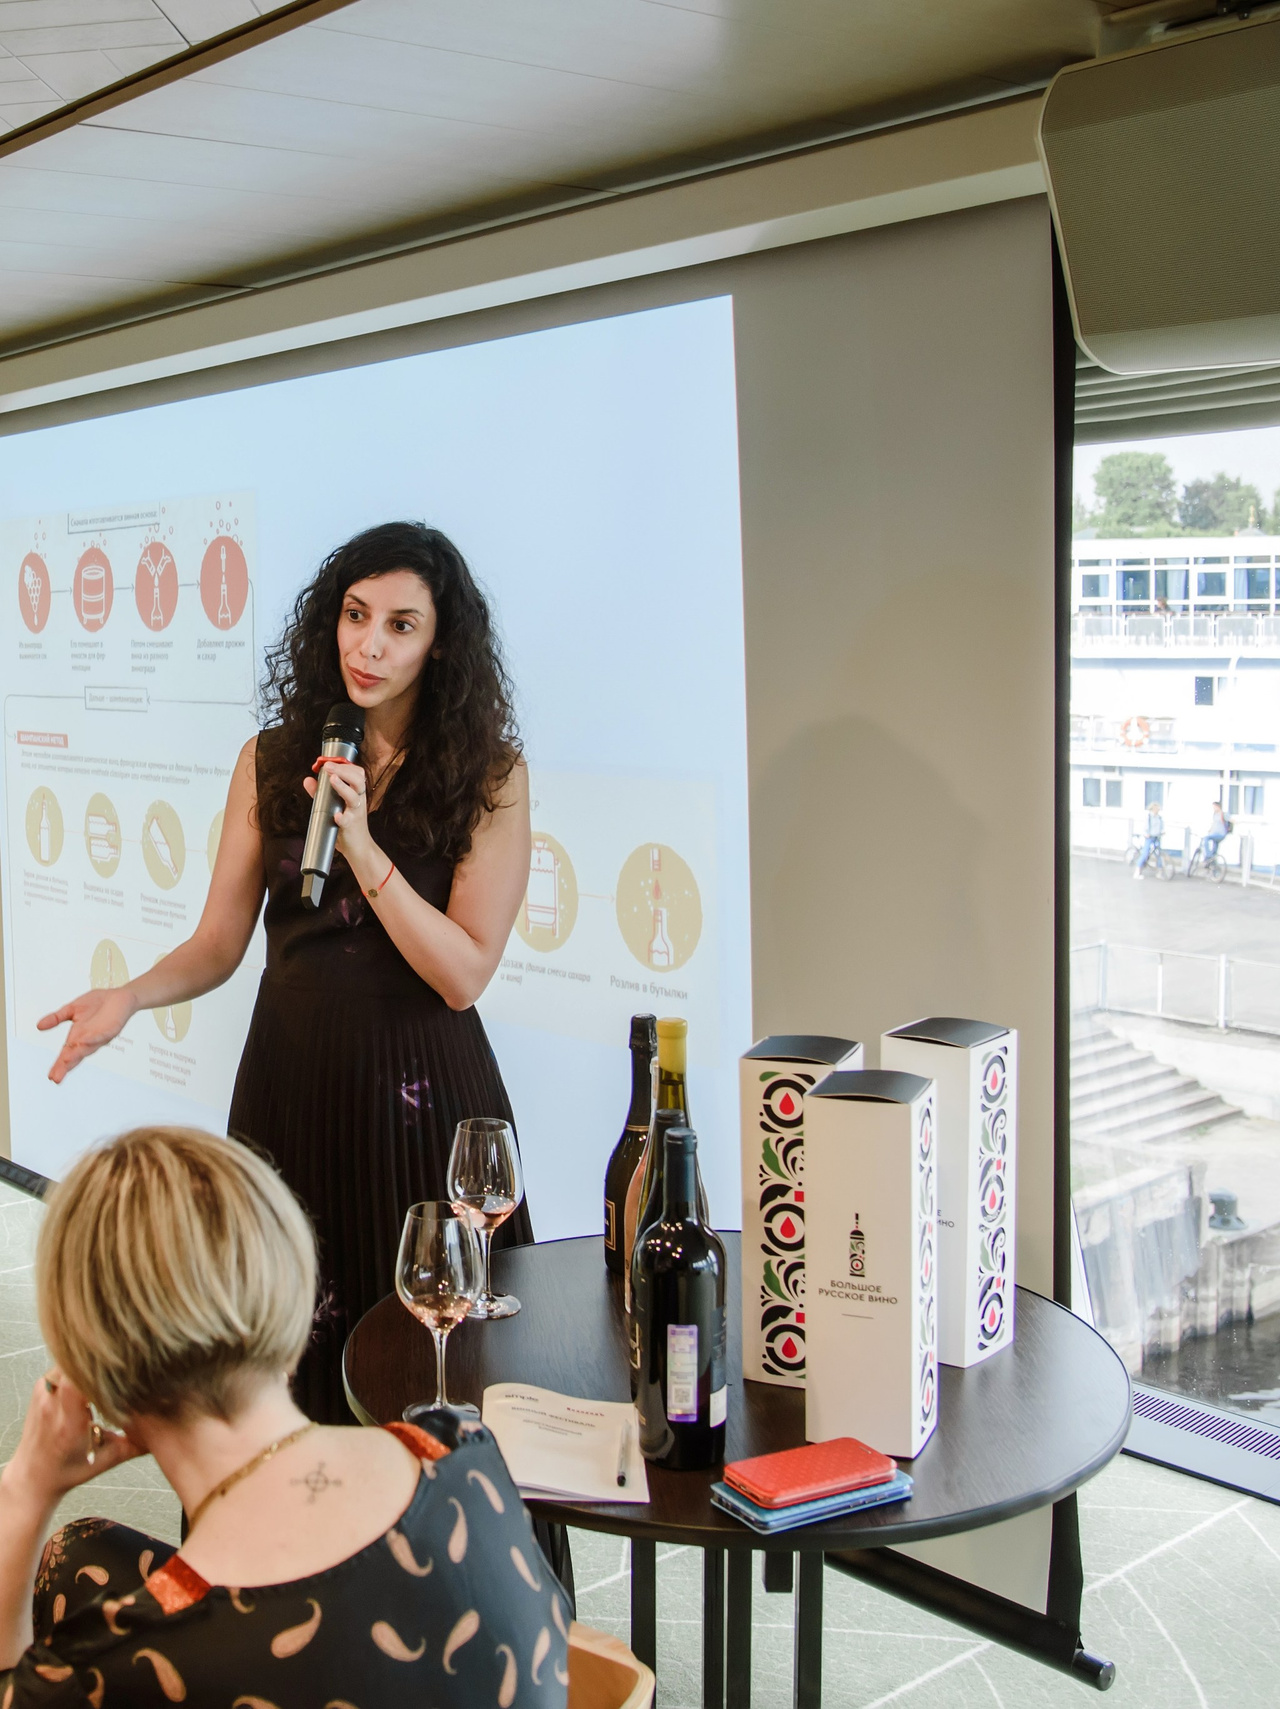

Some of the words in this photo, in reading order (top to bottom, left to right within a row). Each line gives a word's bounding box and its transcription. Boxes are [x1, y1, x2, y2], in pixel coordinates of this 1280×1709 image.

[547, 967, 566, 979] смеси
[568, 970, 591, 983] сахара
[610, 975, 639, 992] Розлив
[642, 984, 647, 993] в
[649, 981, 688, 1000] бутылки
[937, 1220, 954, 1228] ИНО
[830, 1279, 882, 1293] БОЛЬШОЕ
[818, 1288, 865, 1301] РУССКОЕ
[868, 1295, 898, 1305] ВИНО
